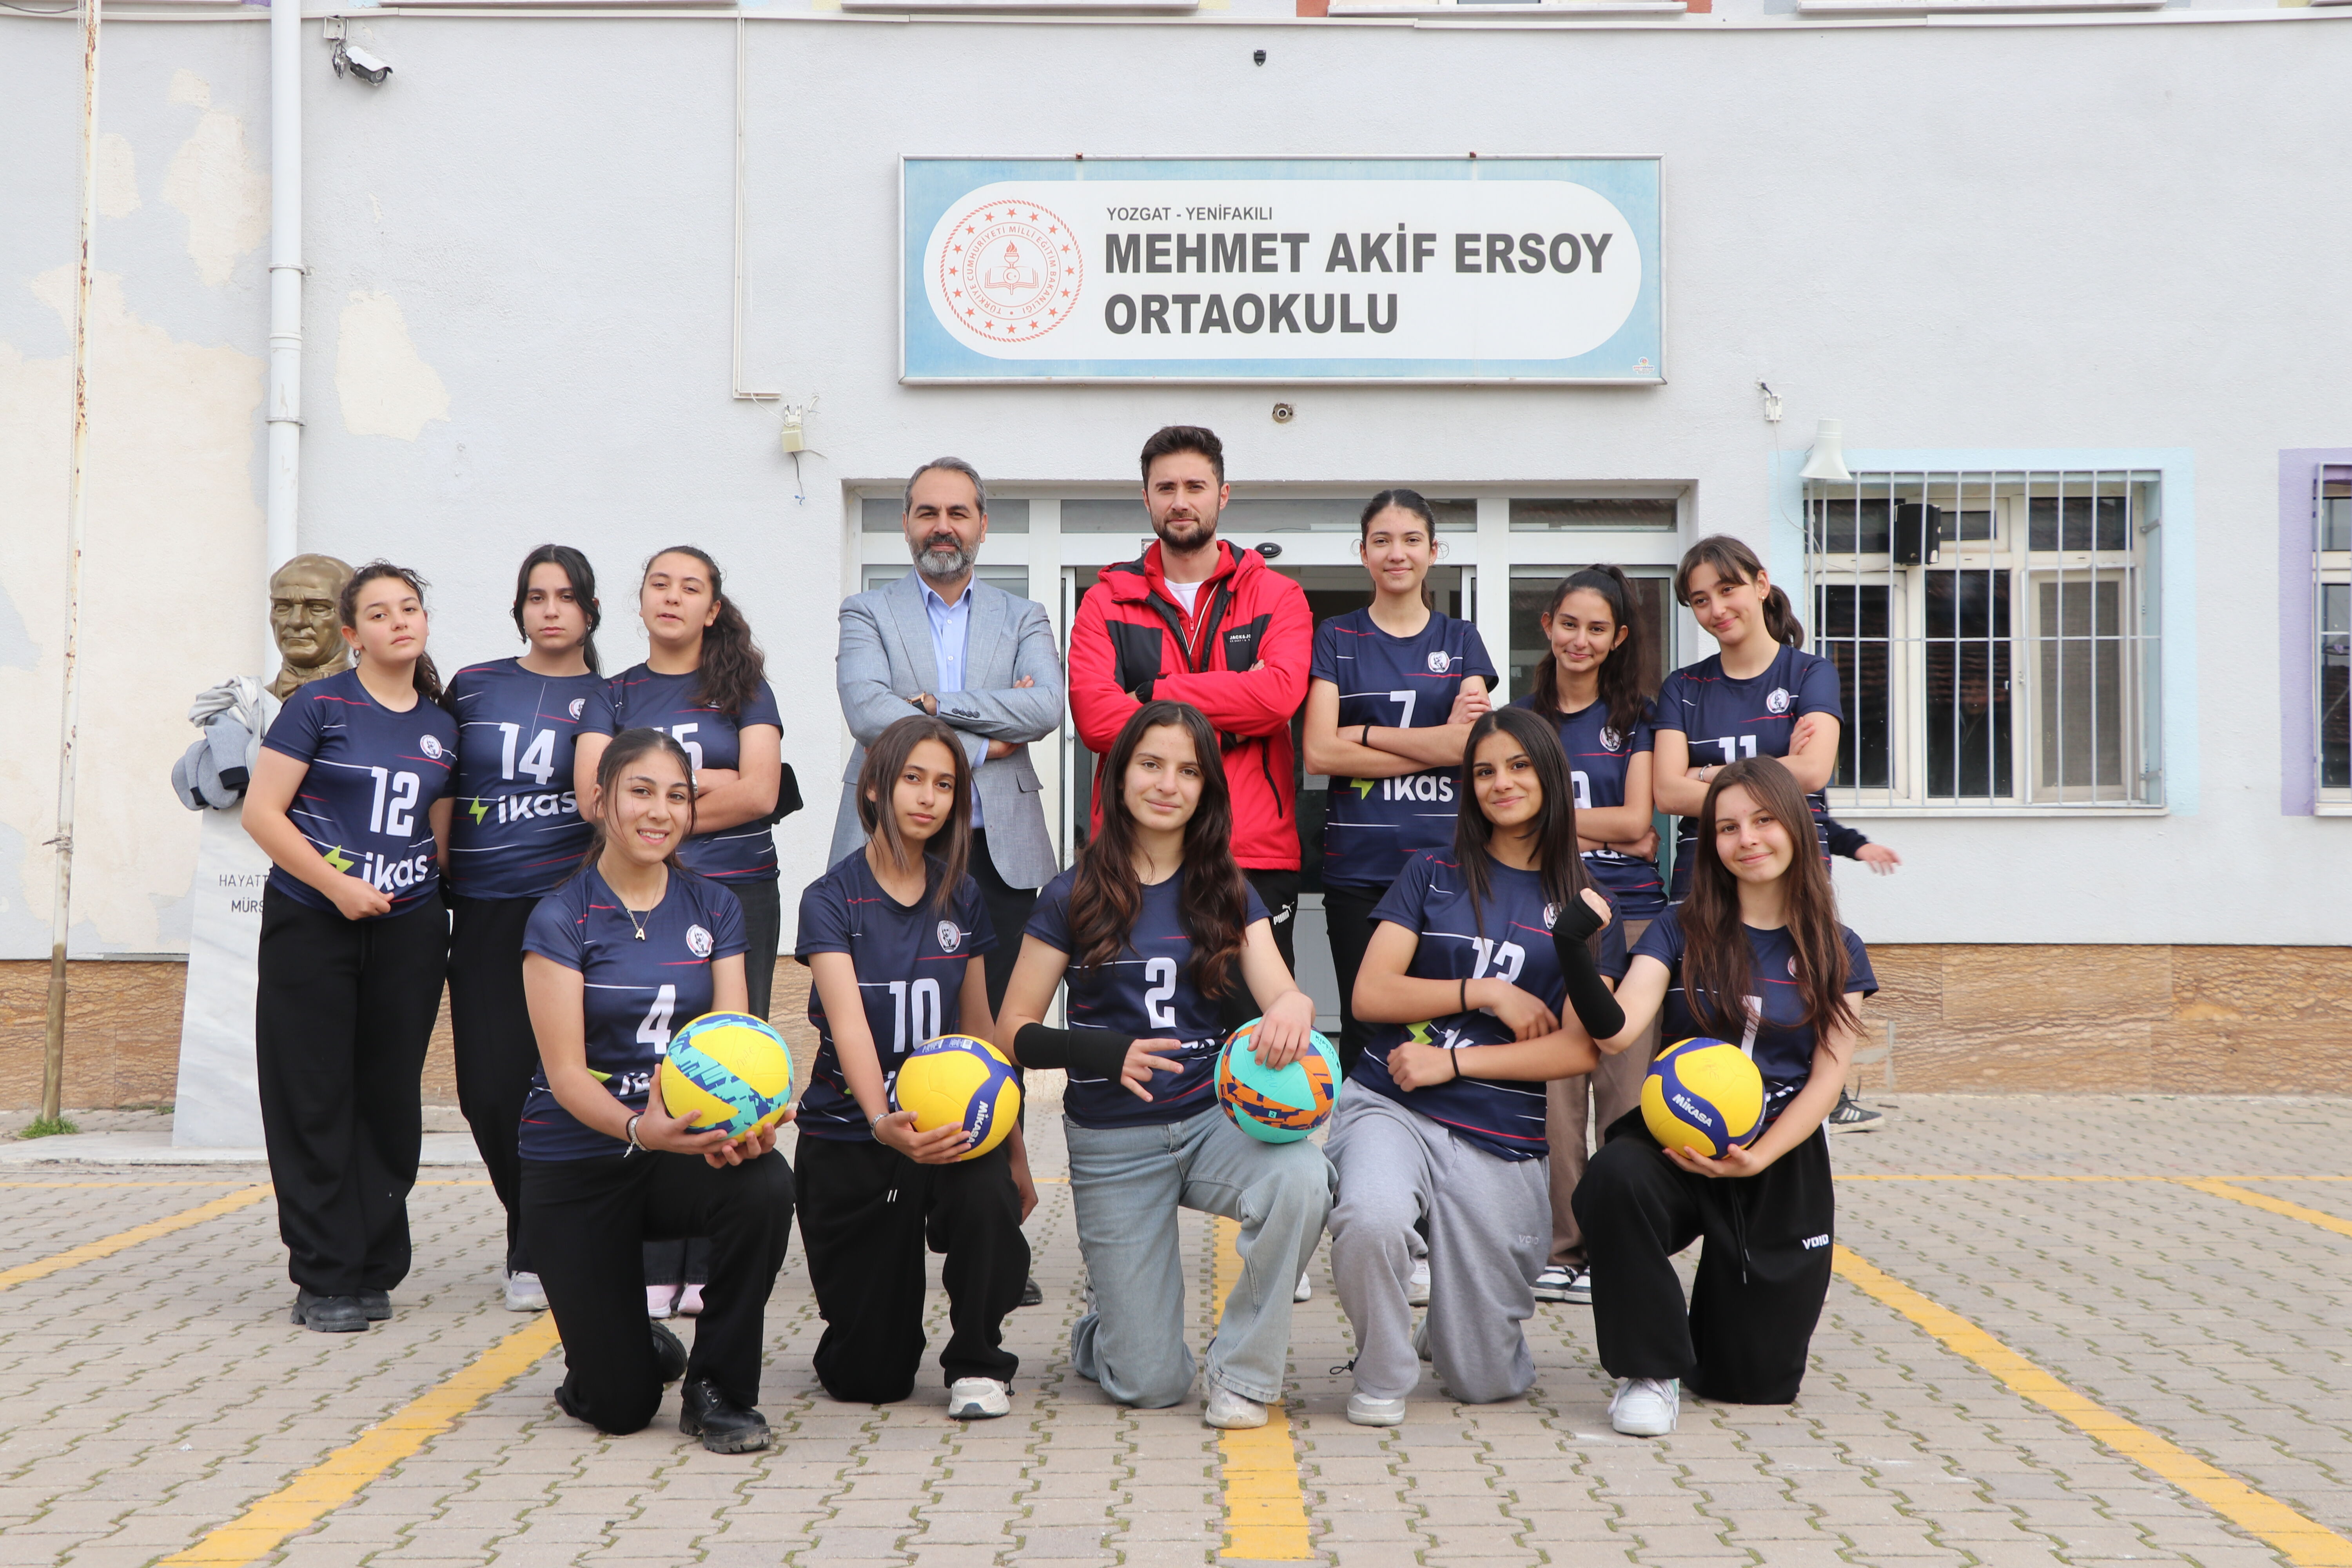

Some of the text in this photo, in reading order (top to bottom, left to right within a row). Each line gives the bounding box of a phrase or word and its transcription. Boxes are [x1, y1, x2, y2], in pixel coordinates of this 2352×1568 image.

[1107, 207, 1171, 221] YOZGAT
[1186, 204, 1272, 220] YENİFAKILI
[967, 225, 1005, 281] CUMHURİYETİ
[1036, 236, 1056, 268] EĞİTİM
[1106, 223, 1613, 274] MEHMET AKİF ERSOY
[969, 285, 1002, 315] TÜRKİYE
[1022, 271, 1056, 314] BAKANLIĞI
[1105, 293, 1397, 334] ORTAOKULU
[1390, 690, 1416, 728] 7
[499, 722, 556, 785] 14
[370, 766, 420, 837] 12
[498, 791, 578, 824] ikas
[1384, 775, 1454, 802] ikas
[363, 851, 428, 891] ikas
[1273, 909, 1290, 926] PUMA
[1144, 957, 1177, 1029] 2
[636, 984, 676, 1054] 4
[889, 978, 940, 1053] 10
